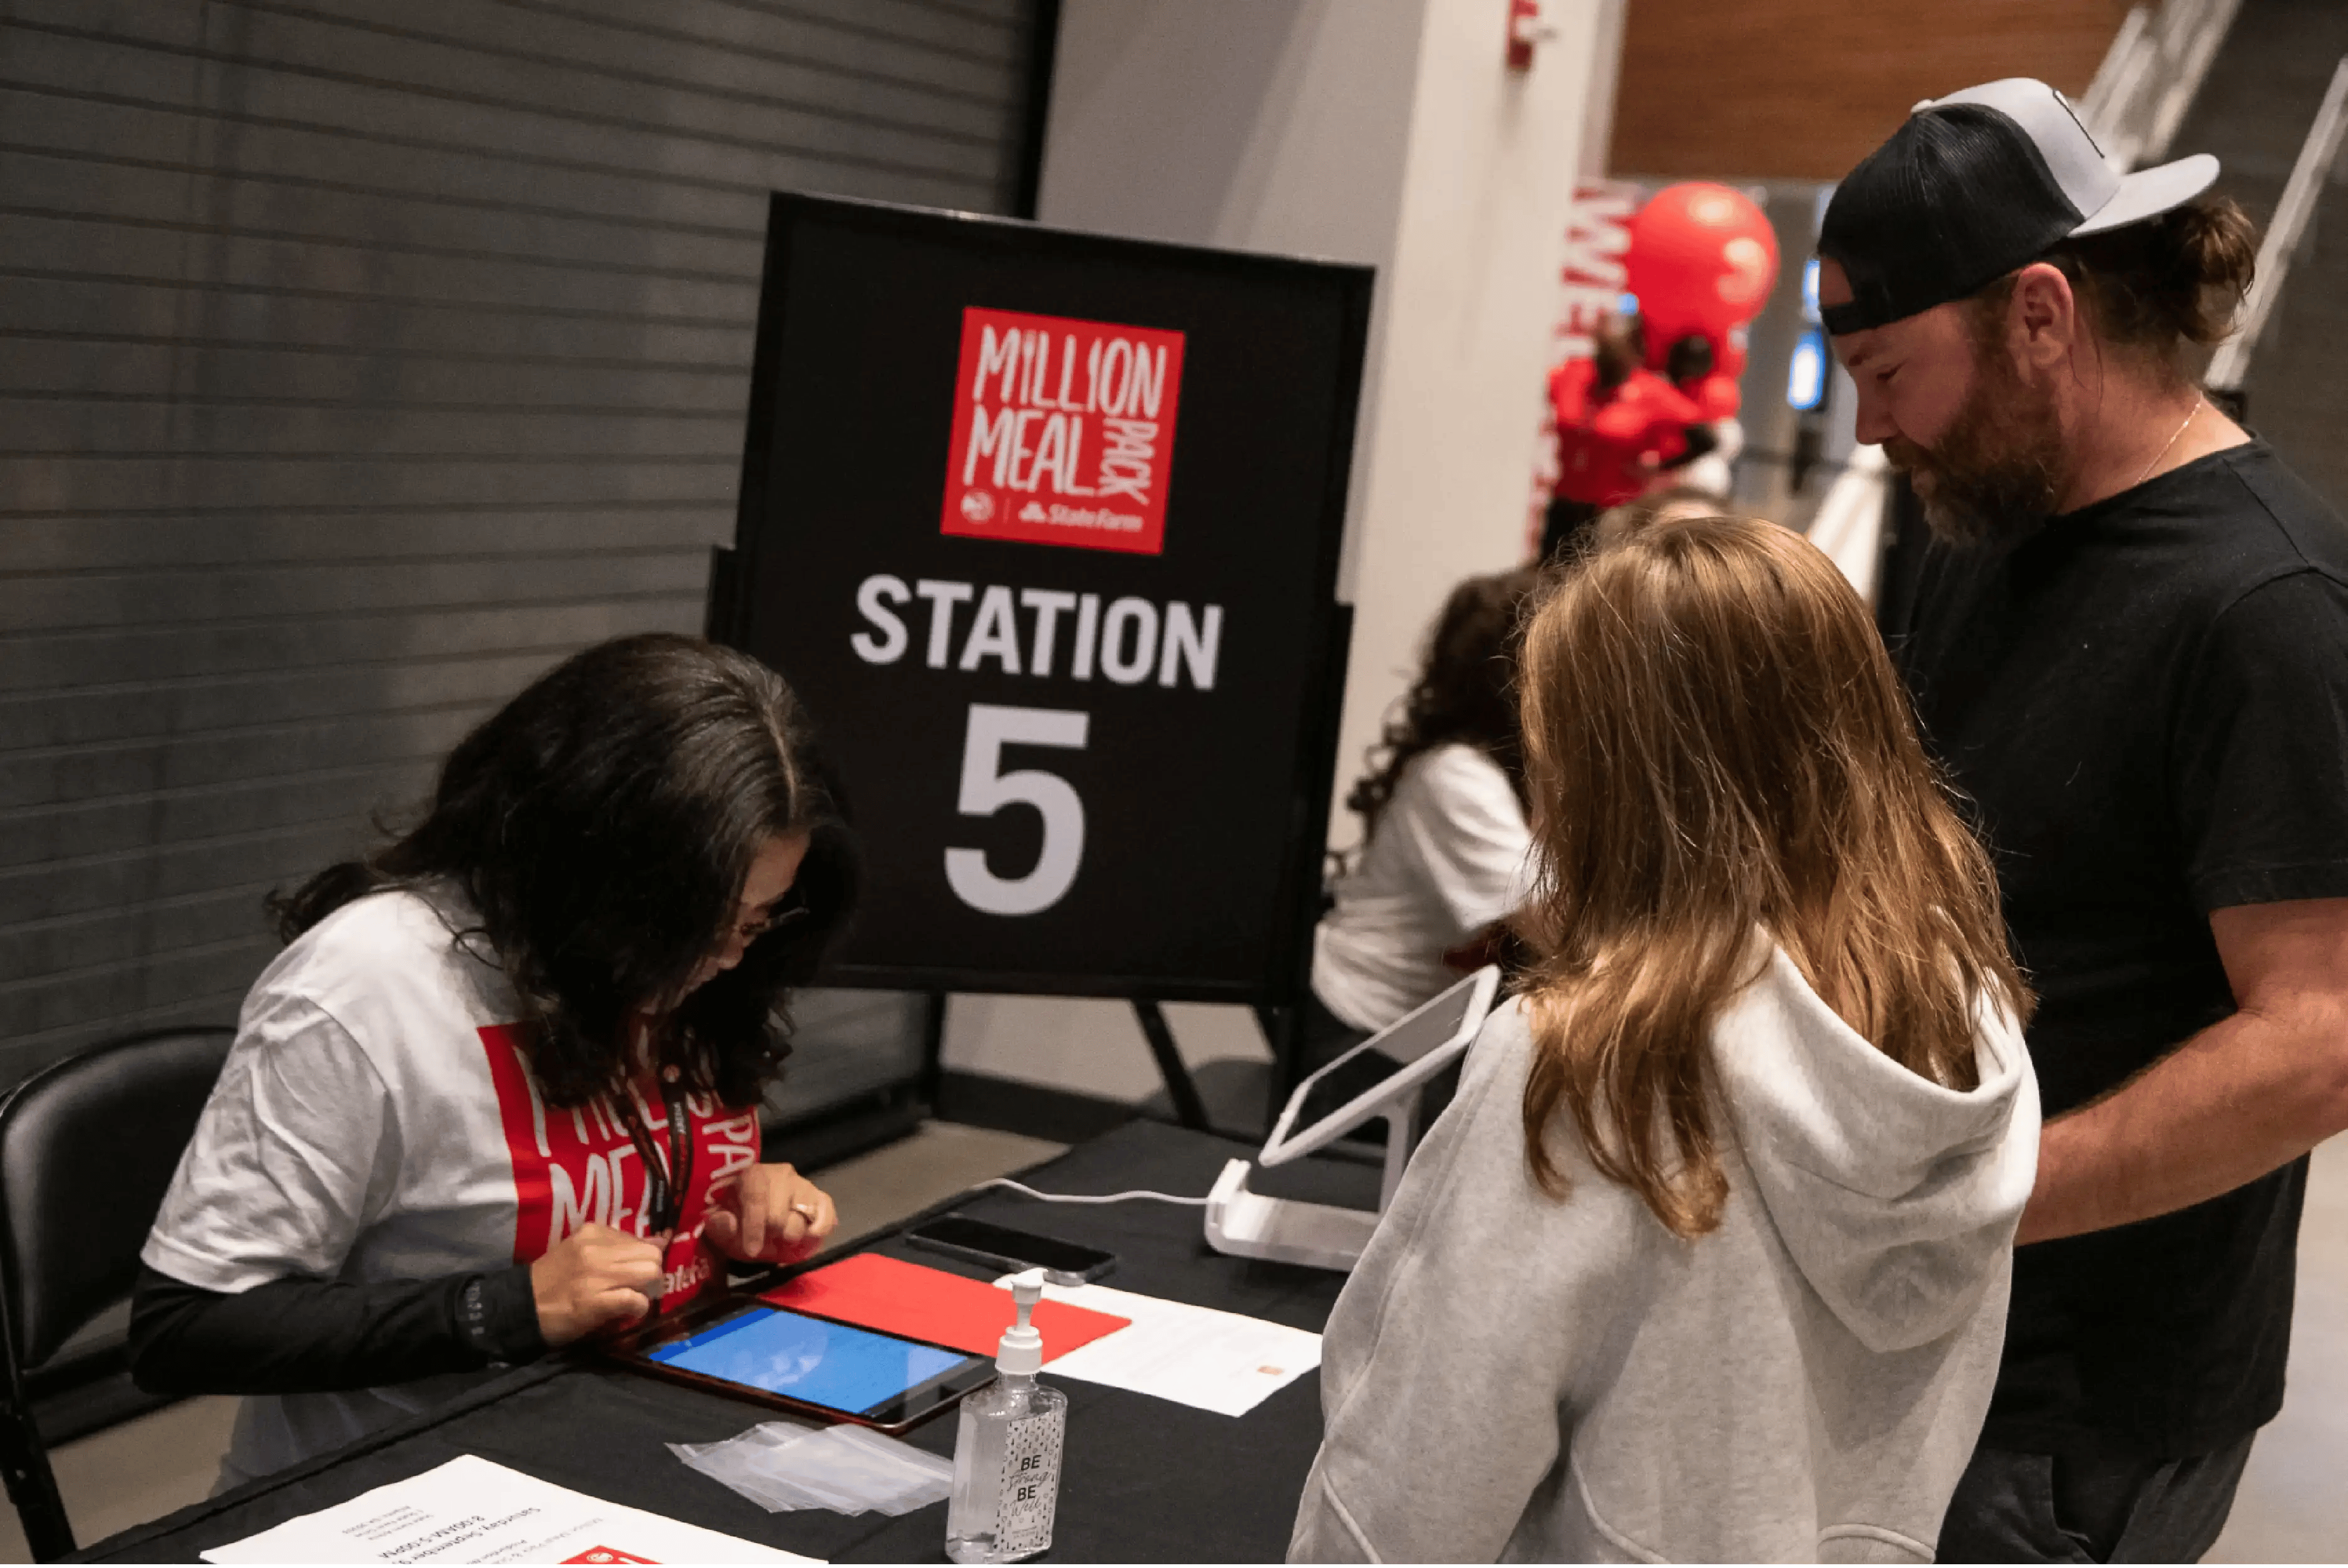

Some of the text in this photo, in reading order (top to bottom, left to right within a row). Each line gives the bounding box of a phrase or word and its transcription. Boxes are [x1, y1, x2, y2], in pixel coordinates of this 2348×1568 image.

[972, 324, 1167, 418] MILLION
[962, 404, 1095, 498] MEAL
[1098, 418, 1158, 505] PACK
[850, 573, 1224, 691] STATION
[944, 702, 1090, 916] 5
[1017, 1483, 1038, 1502] BE
[1021, 1454, 1042, 1471] BE
